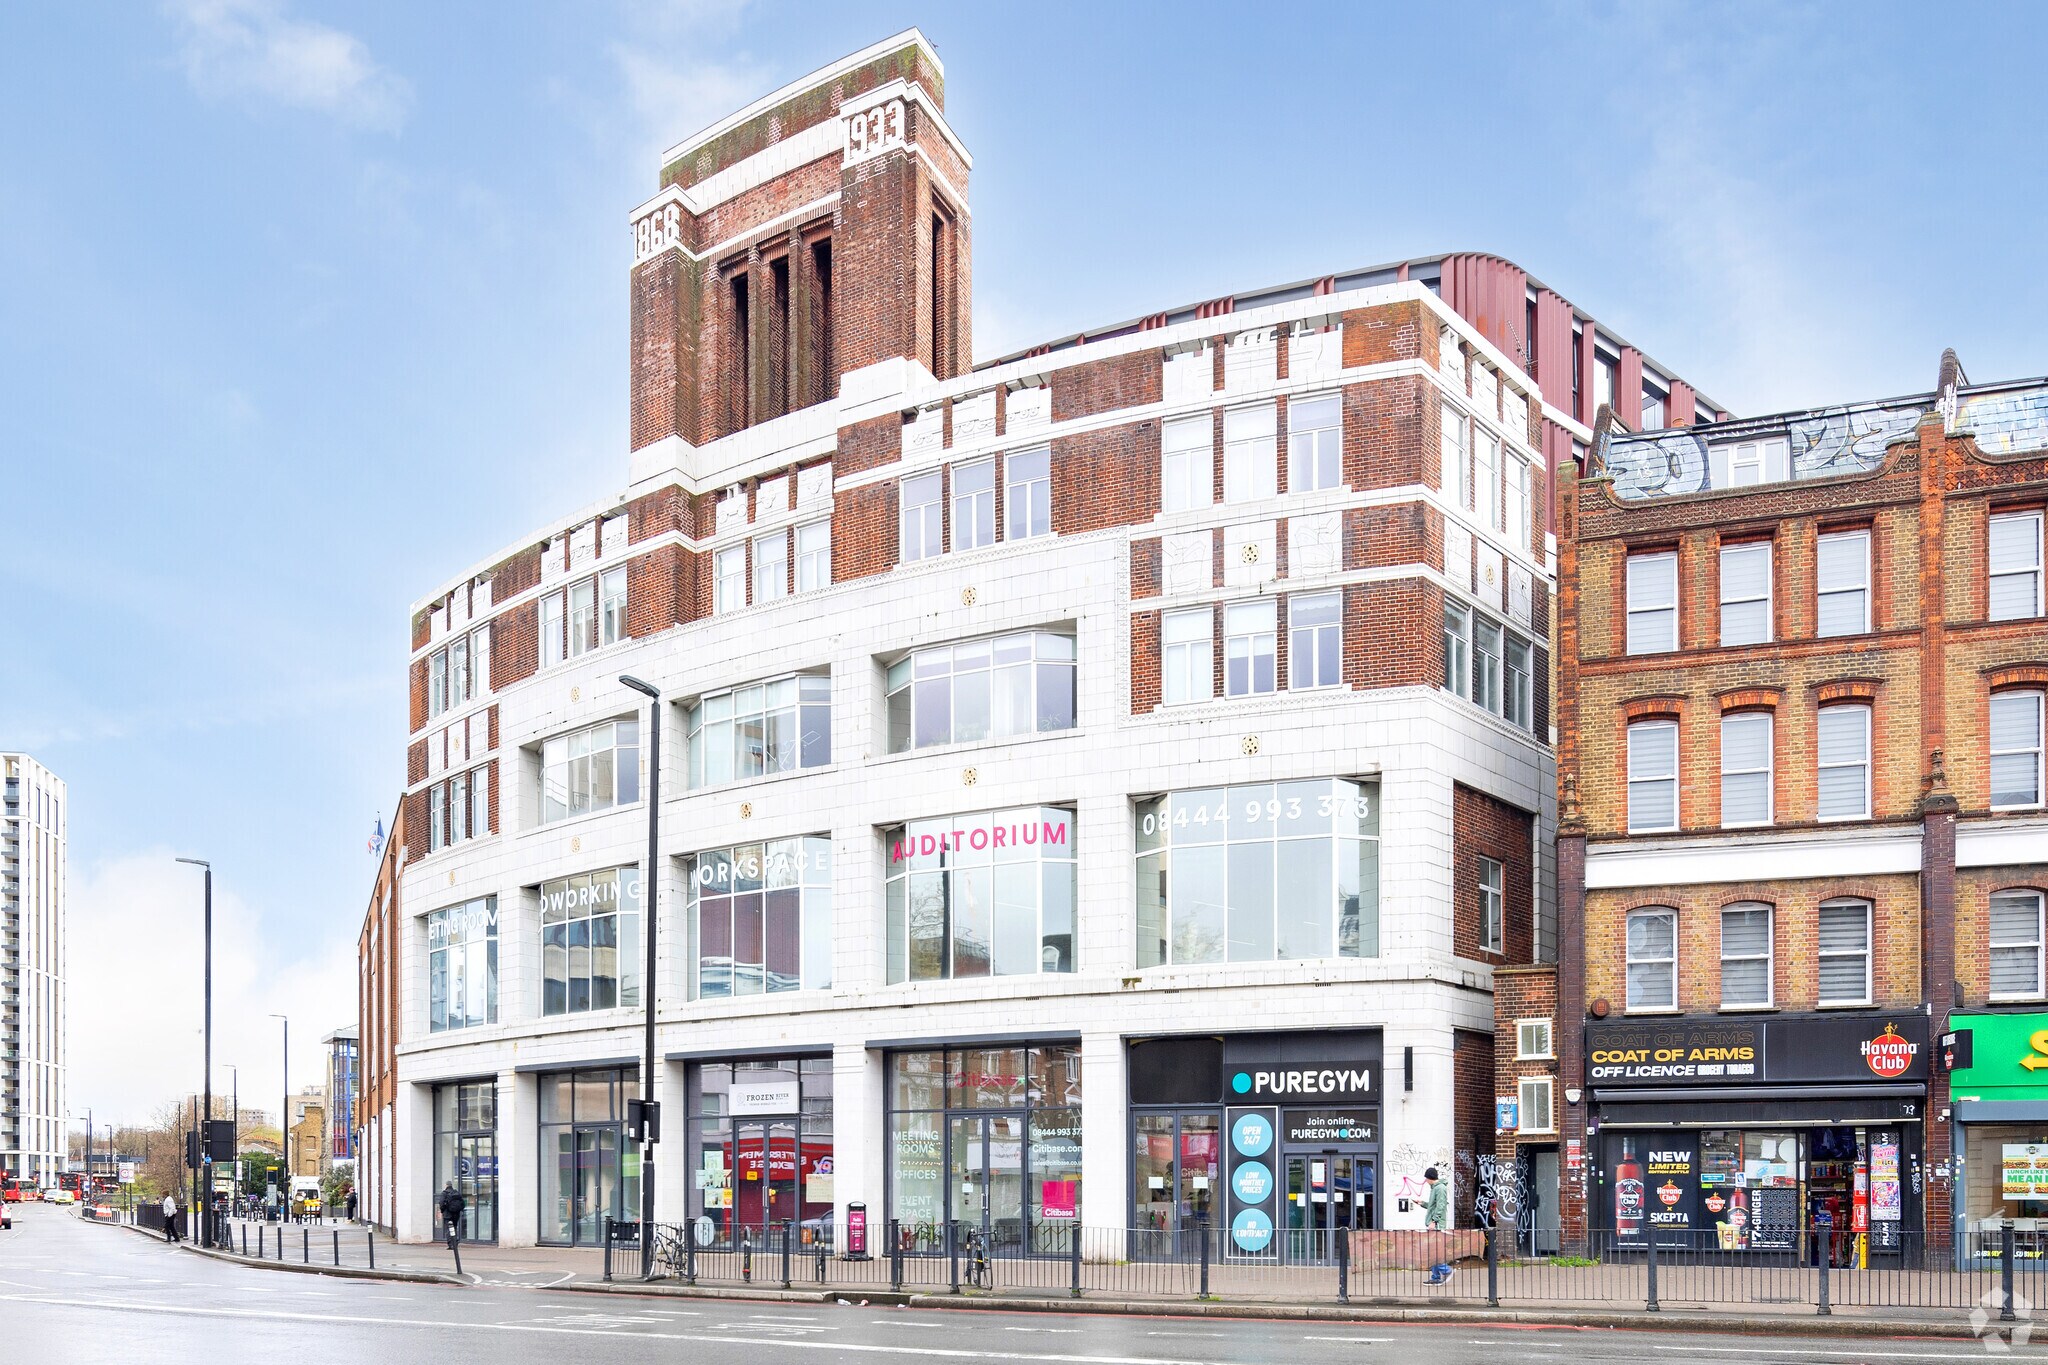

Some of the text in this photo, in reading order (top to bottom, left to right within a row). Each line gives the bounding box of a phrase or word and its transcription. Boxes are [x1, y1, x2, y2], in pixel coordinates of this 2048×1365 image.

[842, 99, 905, 163] 1933
[1142, 795, 1369, 836] 08444 993 373
[892, 822, 1066, 864] AUDITORIUM
[690, 850, 828, 890] WORKSPACE
[1592, 1031, 1754, 1047] COAT OF ARMS
[1861, 1041, 1917, 1056] Havana
[1591, 1047, 1754, 1063] COAT OF ARMS
[1872, 1055, 1905, 1070] Club
[1591, 1066, 1625, 1078] OFF
[1625, 1064, 1695, 1077] LICENCE
[1255, 1069, 1370, 1094] PUREGYM
[746, 1093, 775, 1102] FROZEN
[1306, 1117, 1356, 1126] Join online
[893, 1131, 939, 1141] MEETING
[1032, 1128, 1056, 1137] 08444
[1057, 1128, 1071, 1136] 993
[1242, 1126, 1262, 1135] OPEN
[1243, 1135, 1261, 1145] 24/7
[896, 1144, 935, 1154] ROOMS
[1648, 1151, 1691, 1162] NEW
[894, 1170, 937, 1180] OFFICES
[2007, 1175, 2043, 1183] MEAN
[900, 1196, 932, 1206] EVENT
[899, 1208, 932, 1219] SPACE
[1044, 1208, 1074, 1217] Citibase
[1650, 1212, 1689, 1223] SKEPTA
